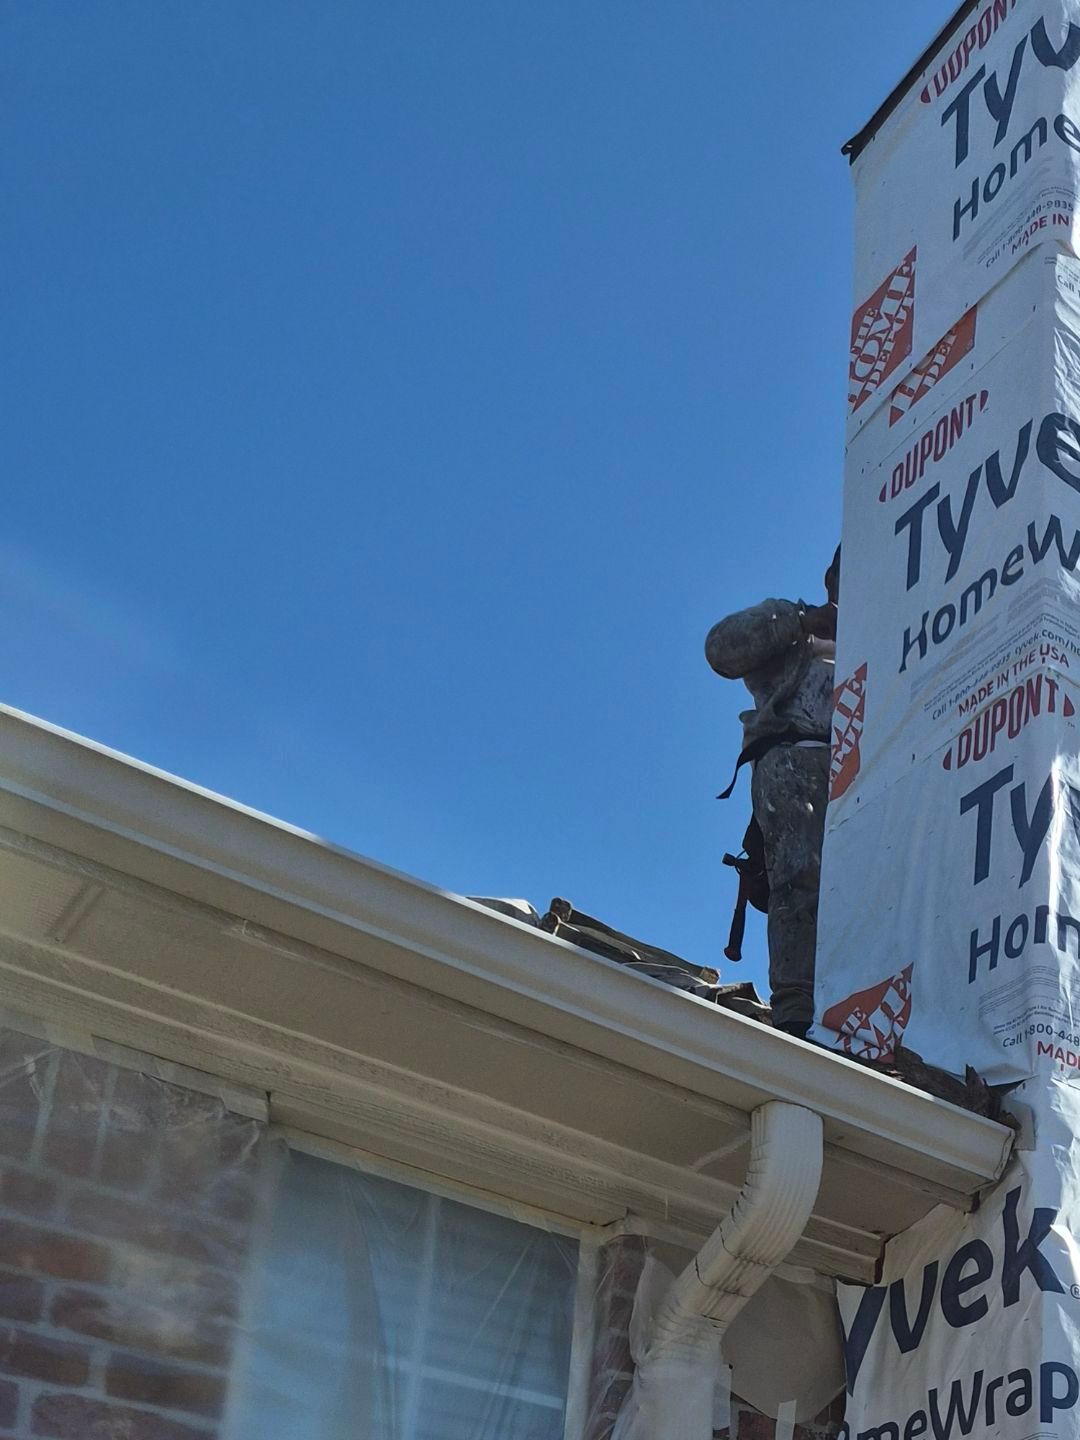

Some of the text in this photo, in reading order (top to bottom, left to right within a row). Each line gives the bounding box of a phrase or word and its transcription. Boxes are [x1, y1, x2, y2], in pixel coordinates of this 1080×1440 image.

[933, 0, 1017, 98] DUPON
[1011, 216, 1048, 255] MADE
[1052, 213, 1070, 228] IN
[1057, 274, 1076, 294] Call
[890, 392, 978, 500] DUPONT
[957, 644, 1070, 718] MADE IN THE USA
[956, 673, 1060, 769] DUPONT
[1002, 1033, 1023, 1048] Call
